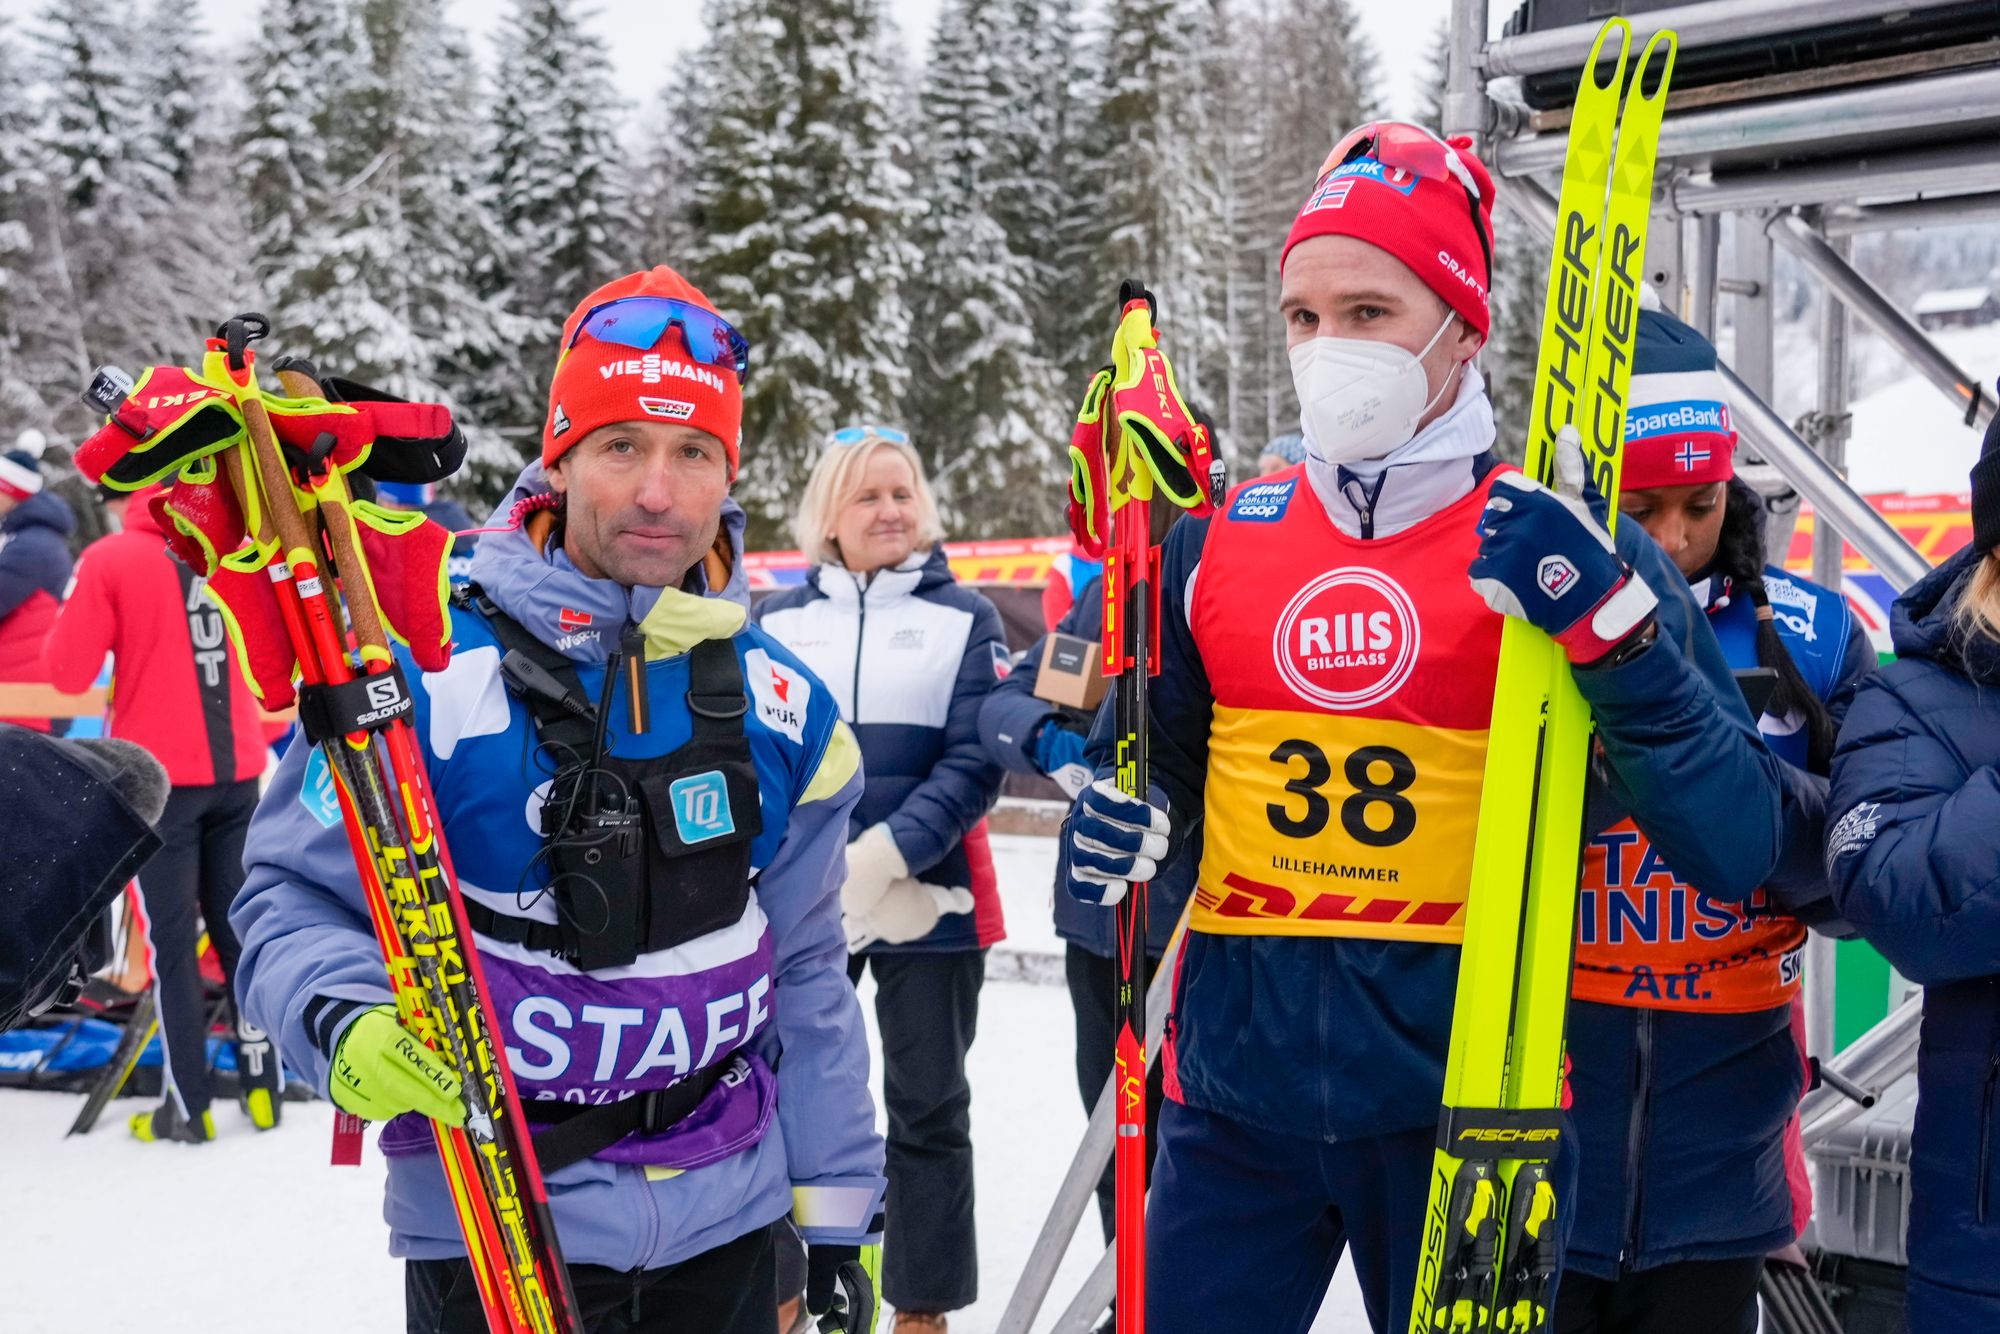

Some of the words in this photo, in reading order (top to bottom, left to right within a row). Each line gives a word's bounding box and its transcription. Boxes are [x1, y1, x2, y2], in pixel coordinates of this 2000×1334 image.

[1438, 250, 1484, 298] CRAFT
[600, 353, 725, 394] VIESSMANN
[1147, 355, 1174, 419] LEKI
[148, 389, 233, 409] LEKI
[1624, 406, 1720, 437] SpareBank
[1238, 496, 1268, 505] WORLD
[1269, 495, 1288, 504] CUP
[187, 574, 227, 687] AUT
[1106, 556, 1116, 665] LEKI
[1300, 610, 1393, 657] RIIS
[1307, 652, 1387, 671] BILGLASS
[679, 783, 724, 830] TQ
[1265, 738, 1417, 847] 38
[1272, 855, 1399, 883] LILLEHAMMER
[382, 846, 437, 957] LEKI
[419, 866, 466, 985] LEKI
[504, 972, 770, 1082] STAFF
[1458, 1127, 1561, 1142] FISCHER
[1414, 1167, 1449, 1334] FISCH
